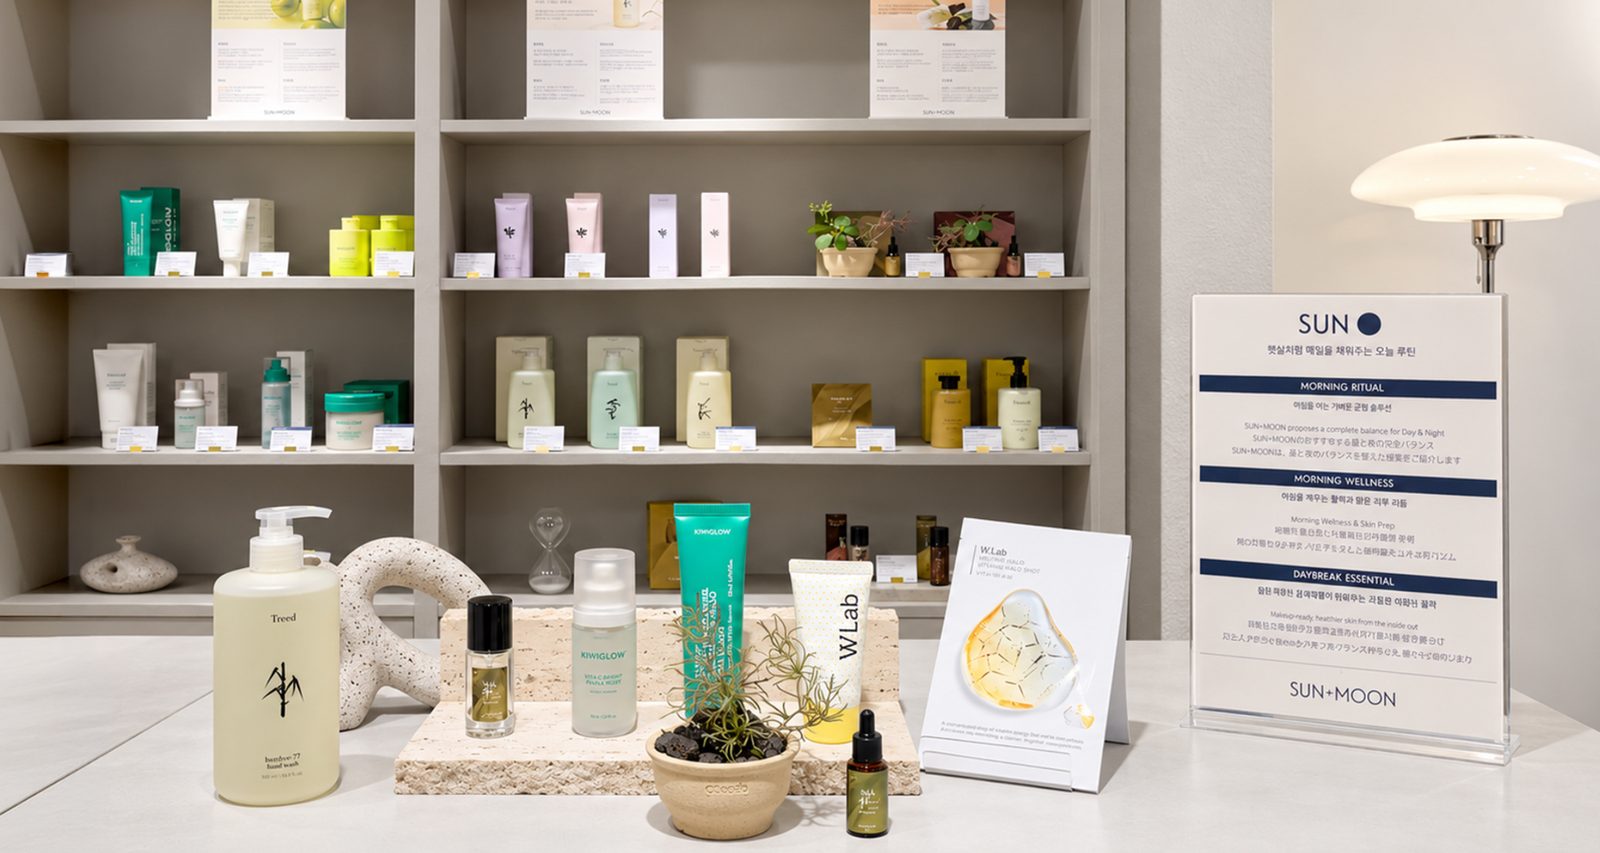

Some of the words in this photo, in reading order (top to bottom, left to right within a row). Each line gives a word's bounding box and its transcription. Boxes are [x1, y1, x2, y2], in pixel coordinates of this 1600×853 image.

[1298, 313, 1349, 335] SUN
[1375, 346, 1394, 358] 오늘
[1300, 381, 1349, 392] MORNING
[1351, 383, 1385, 393] RITUAL
[1360, 427, 1388, 435] balance
[1401, 428, 1417, 437] Day
[1425, 429, 1446, 439] Night
[1293, 474, 1342, 486] MORNING
[1344, 476, 1394, 489] WELLNESS
[1290, 516, 1320, 526] Morning
[1360, 520, 1376, 528] Skin
[1377, 521, 1396, 530] Prep
[980, 545, 1008, 557] W.Lab
[1293, 569, 1343, 583] DAYBREAK
[1345, 573, 1395, 587] ESSENTIAL
[270, 613, 297, 624] Treed
[581, 650, 625, 661] KIWIGLOW
[1289, 680, 1397, 708] SUN+MOON
